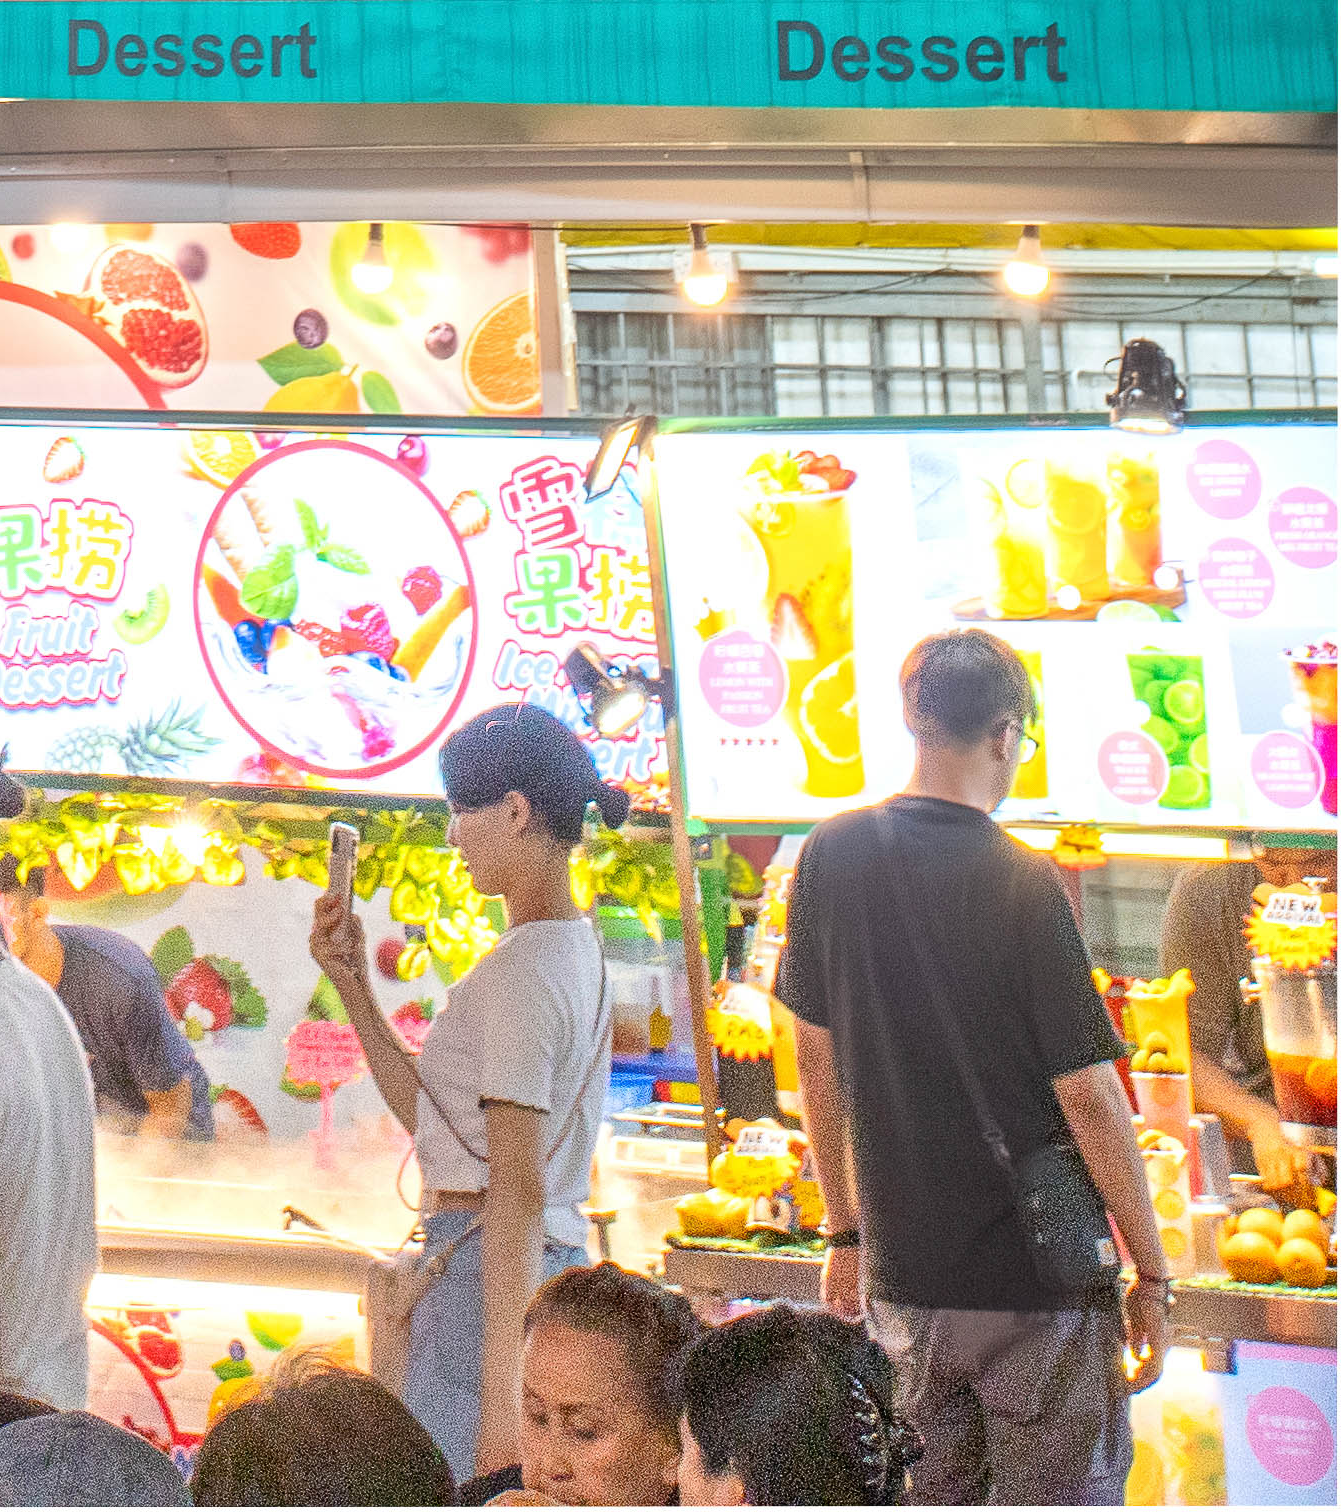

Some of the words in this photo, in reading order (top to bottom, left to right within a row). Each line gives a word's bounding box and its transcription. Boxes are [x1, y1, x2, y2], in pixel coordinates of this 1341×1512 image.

[67, 18, 317, 80] Dessert
[777, 20, 1068, 84] Dessert
[512, 552, 656, 631] 果捞
[3, 606, 95, 655] Fruit
[498, 647, 553, 686] Ice
[1273, 897, 1318, 912] NEW
